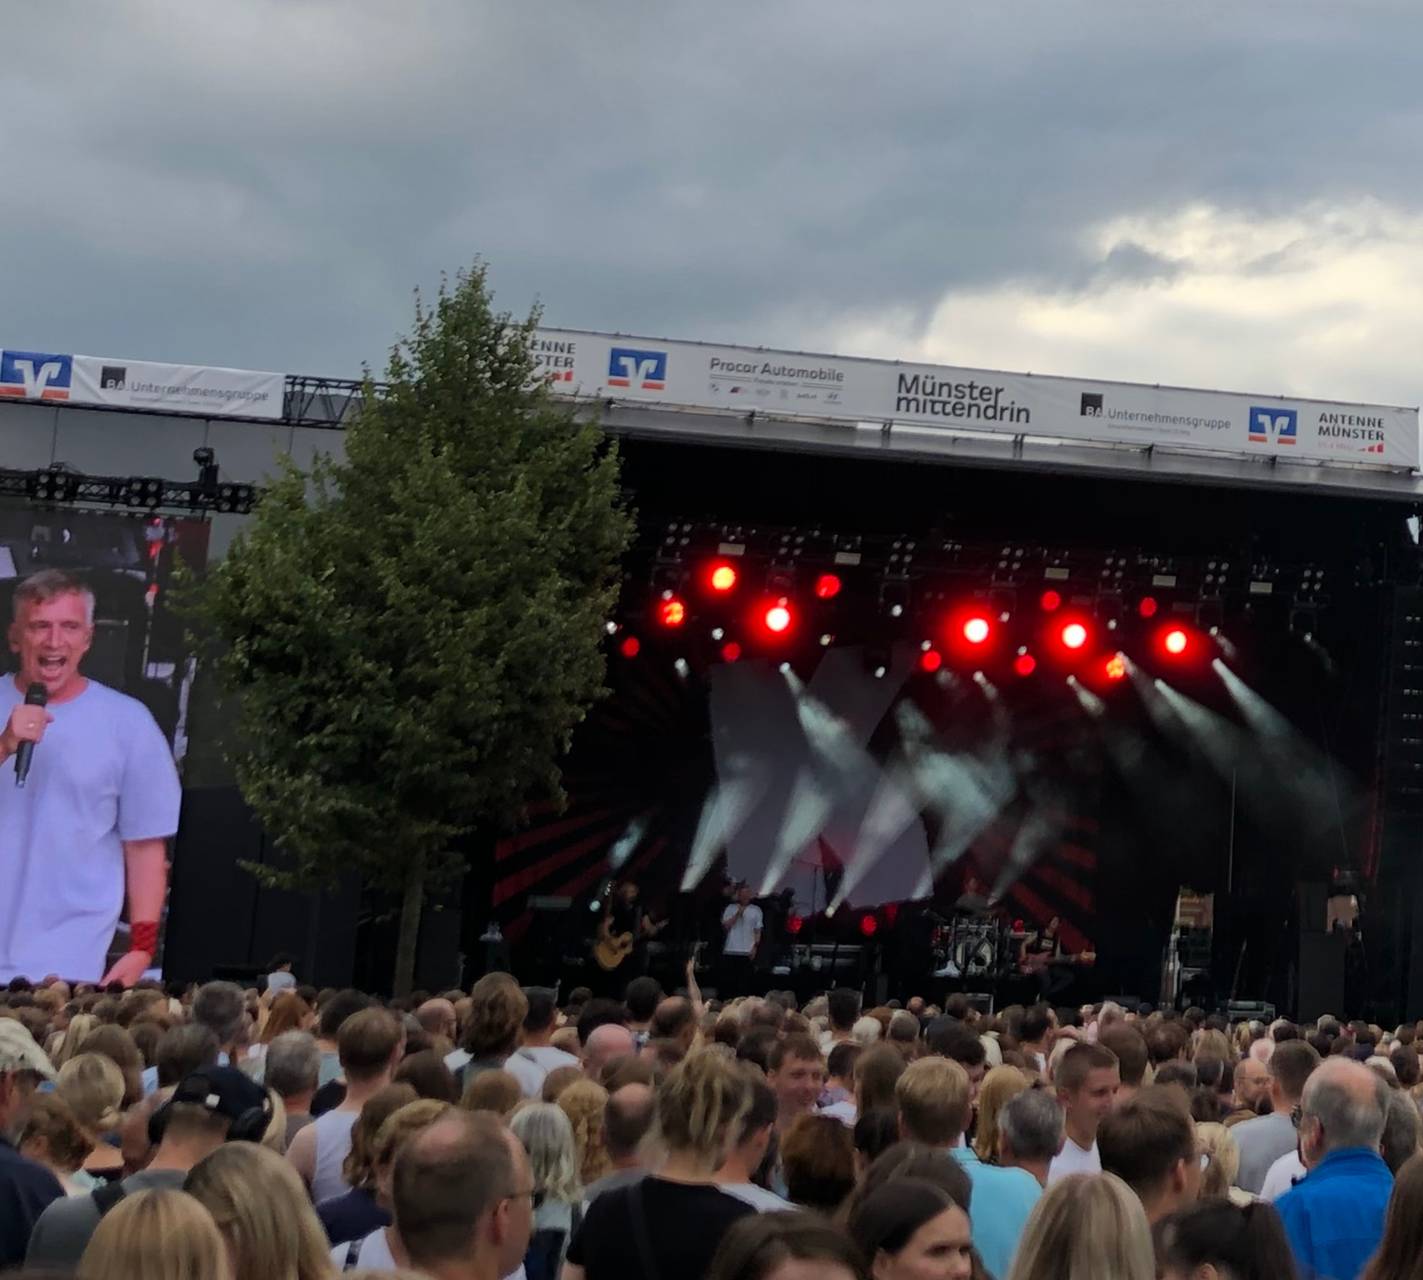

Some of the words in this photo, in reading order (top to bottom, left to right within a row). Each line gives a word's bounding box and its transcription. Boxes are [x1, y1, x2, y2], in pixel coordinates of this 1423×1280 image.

[531, 339, 576, 354] ENNE
[535, 354, 575, 368] STER
[710, 357, 758, 374] Procar
[760, 362, 845, 382] Automobile
[130, 381, 269, 401] Unternehmensgruppe
[898, 372, 1004, 402] Münster
[896, 387, 1030, 423] mittendrin
[1107, 408, 1232, 430] Unternehmensgruppe
[1319, 412, 1385, 429] ANTENNE
[1318, 424, 1384, 441] MÜNSTER
